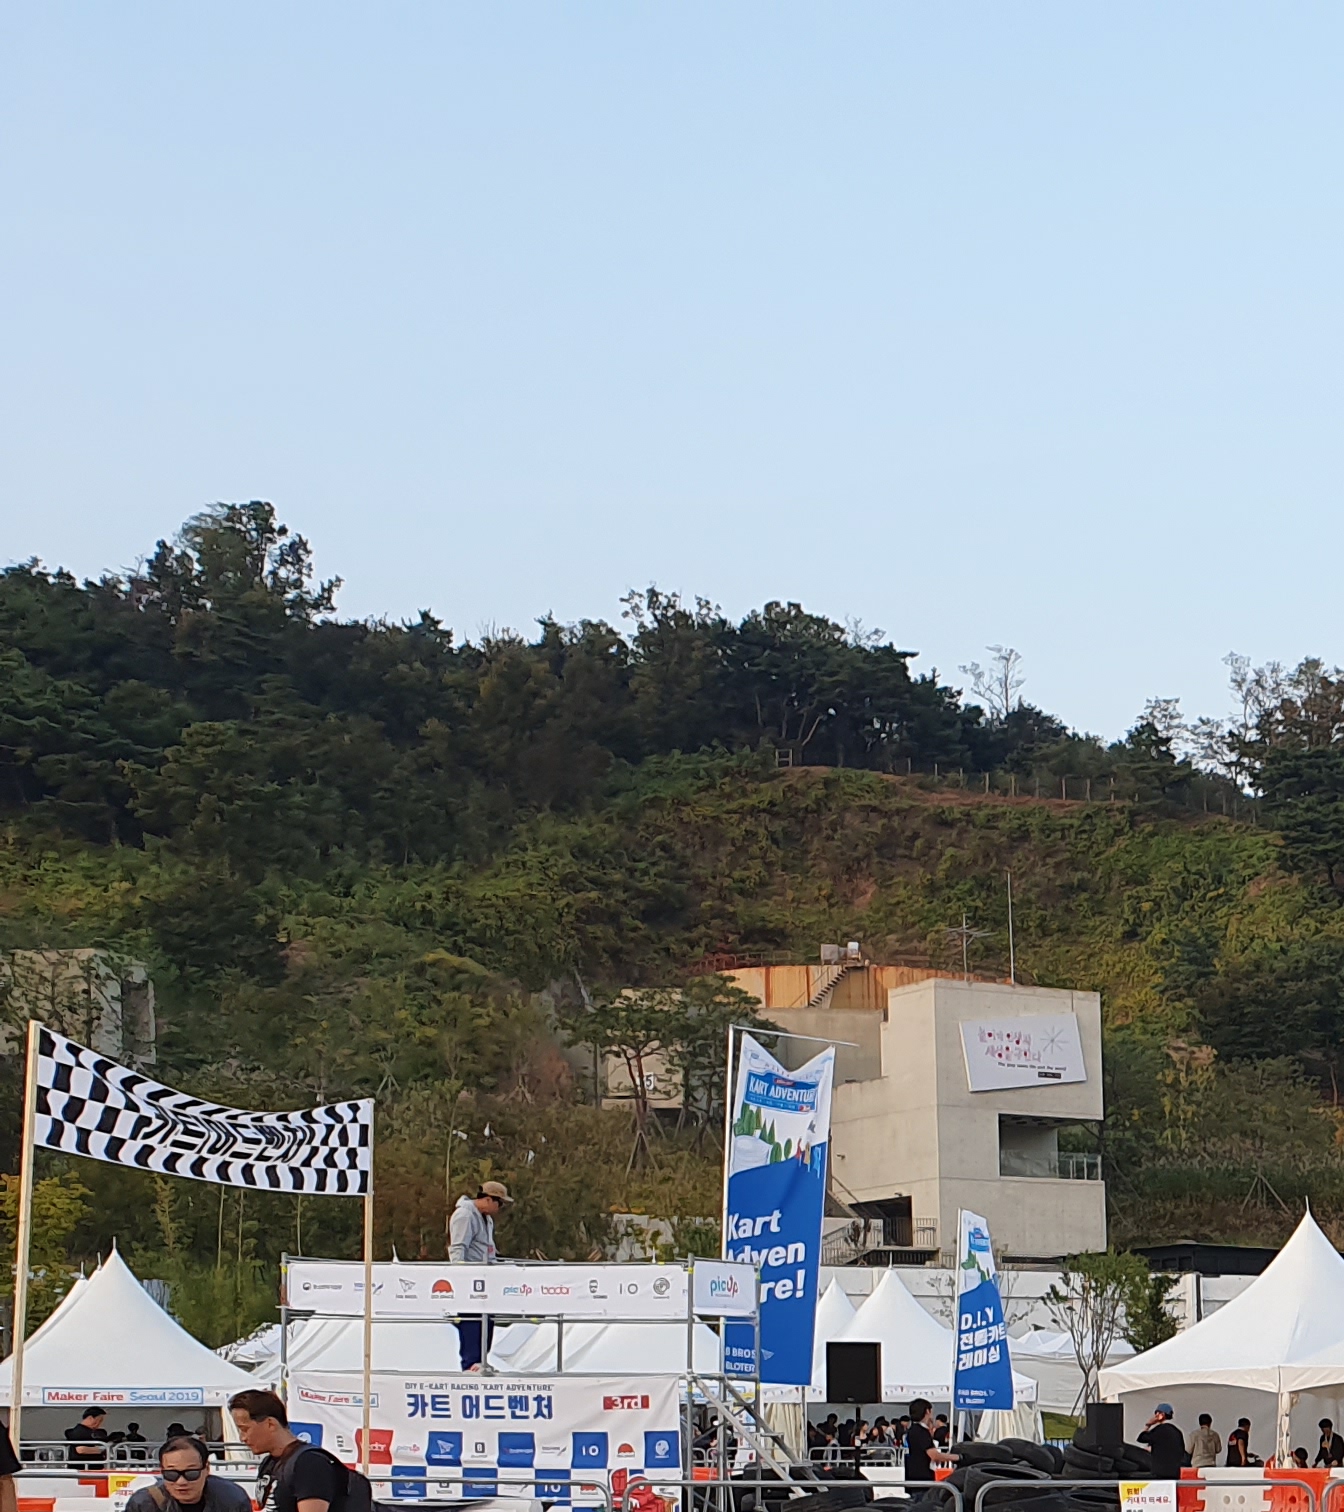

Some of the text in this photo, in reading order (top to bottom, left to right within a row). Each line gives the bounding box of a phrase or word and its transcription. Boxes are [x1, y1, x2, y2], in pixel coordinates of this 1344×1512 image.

[749, 1076, 769, 1095] KART
[728, 1209, 782, 1241] Kart
[960, 1306, 995, 1331] D.I.Y
[47, 1391, 200, 1402] Maker Faire Seoul 2019
[406, 1393, 554, 1420] 카트 어드벤처
[611, 1395, 642, 1409] 3rd
